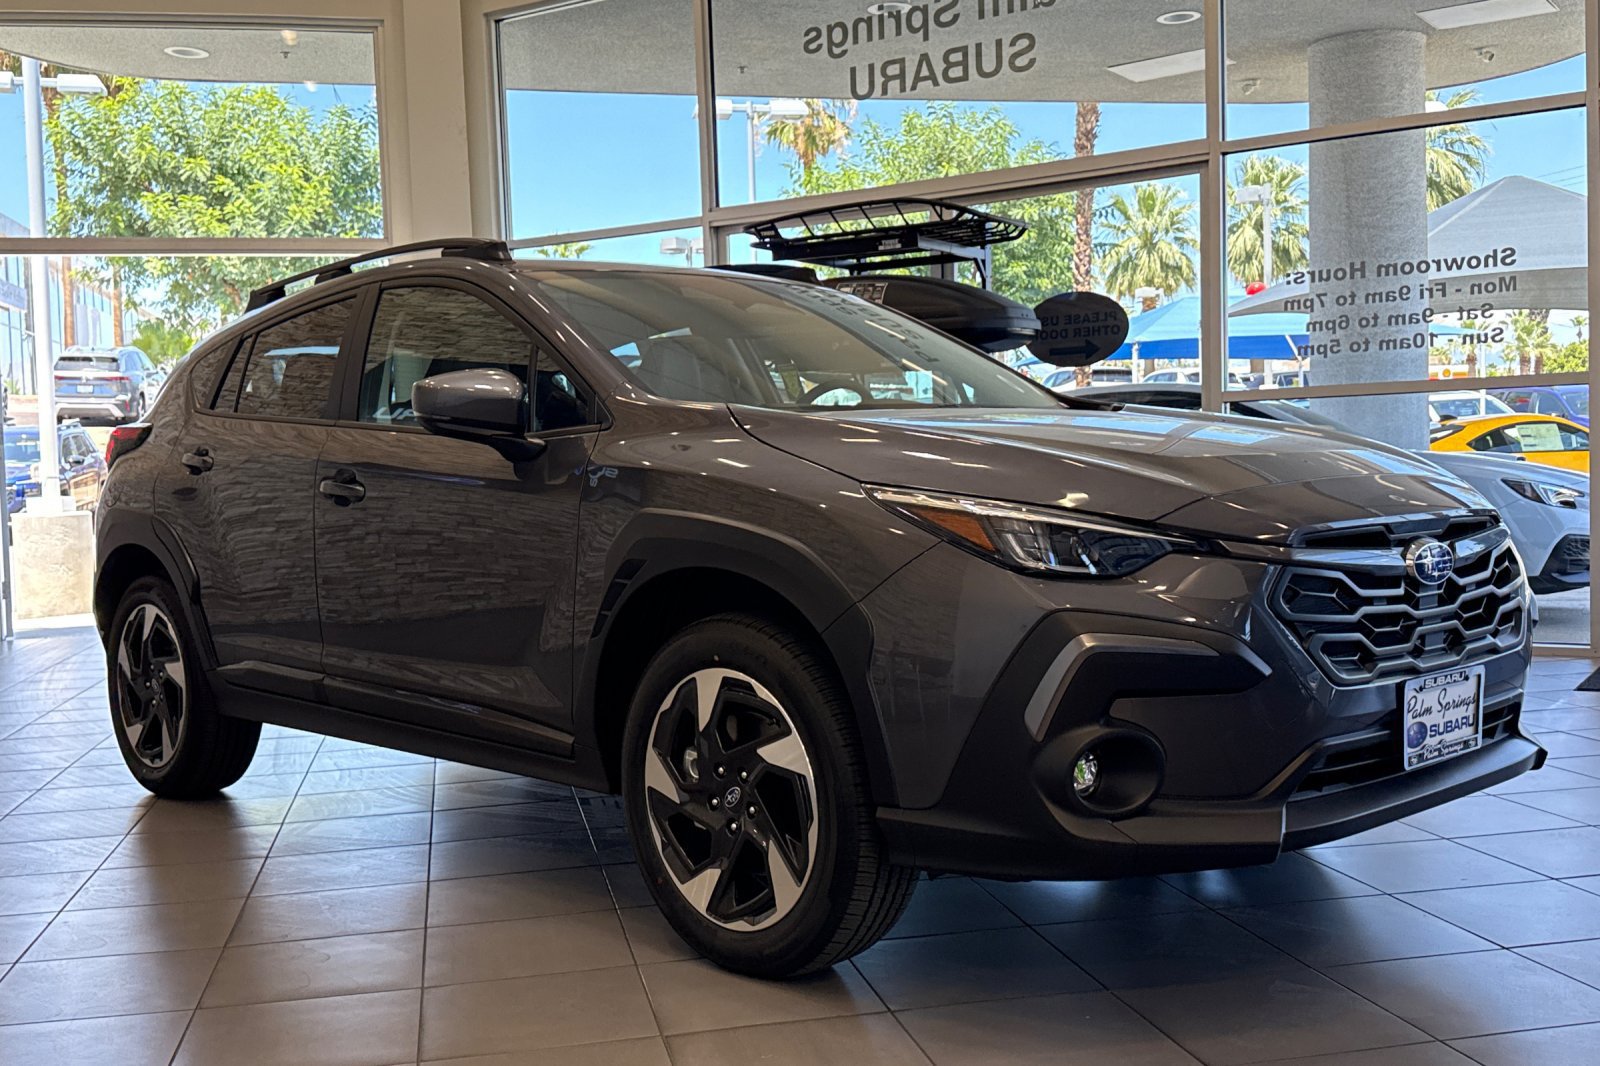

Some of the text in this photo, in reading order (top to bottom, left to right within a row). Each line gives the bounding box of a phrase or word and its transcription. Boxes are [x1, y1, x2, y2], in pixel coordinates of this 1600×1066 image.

[1424, 671, 1465, 689] SUBARU
[1407, 687, 1477, 720] Palm Springs
[1429, 713, 1475, 738] SUBARU
